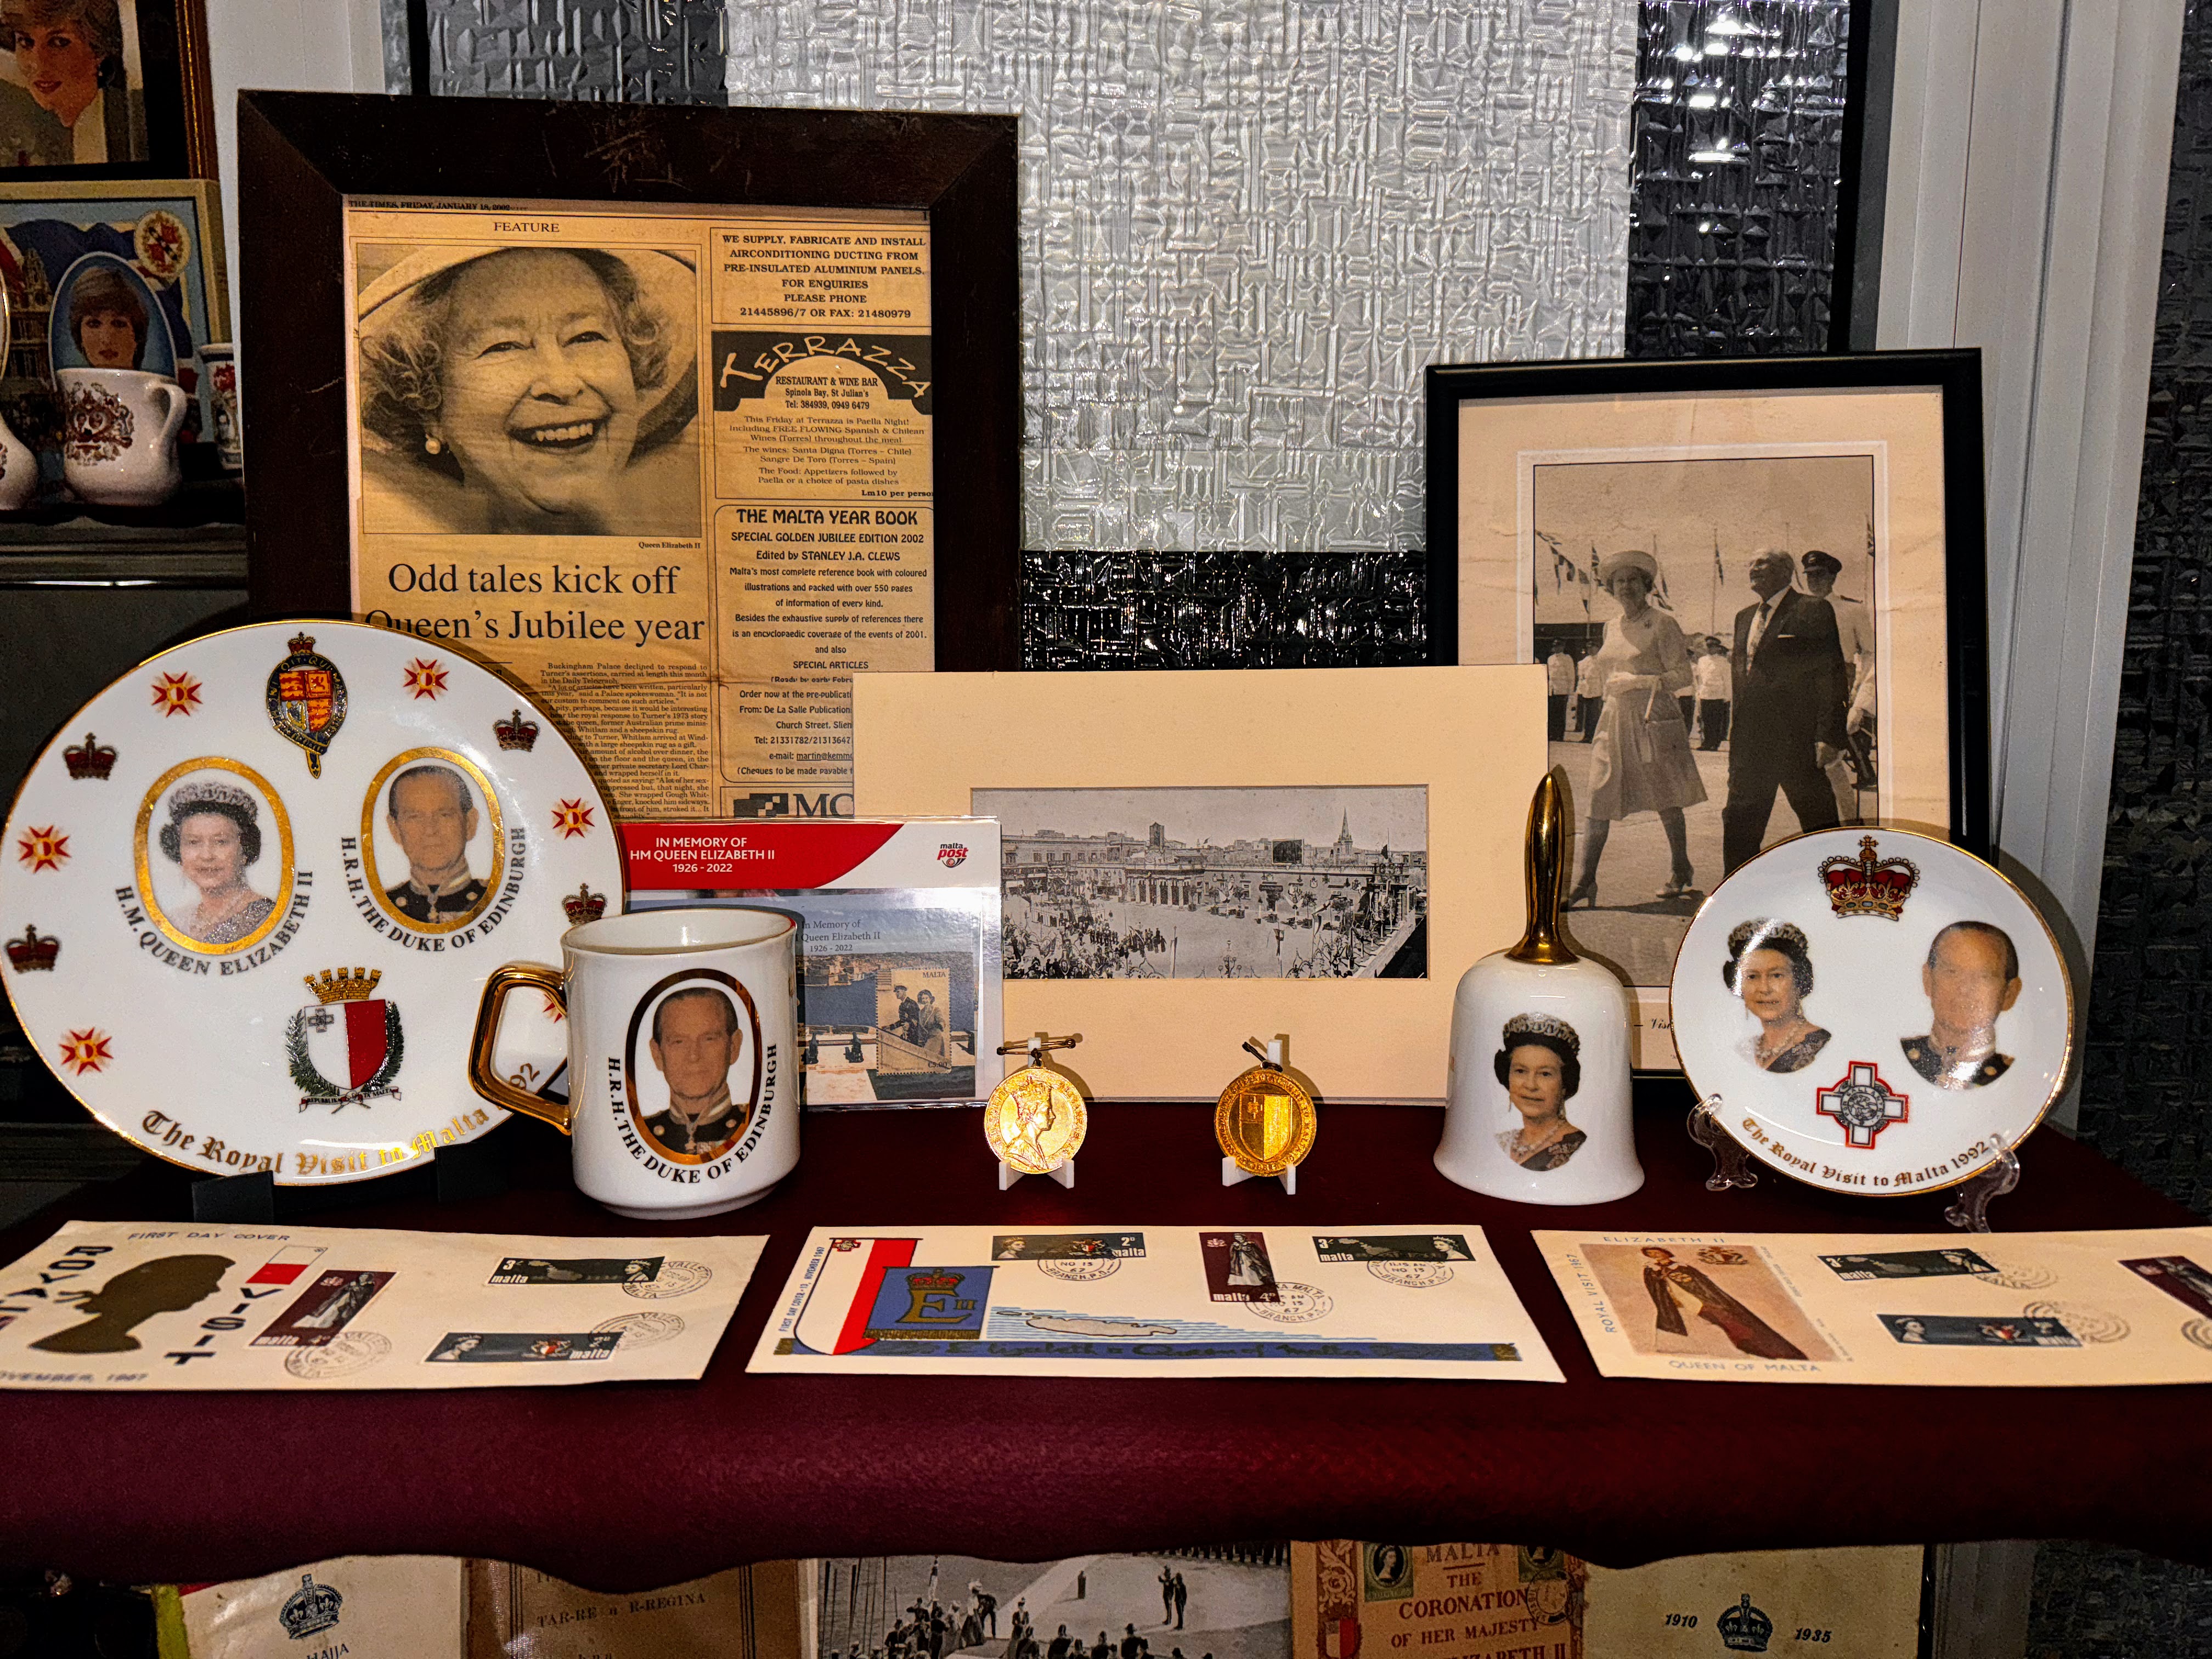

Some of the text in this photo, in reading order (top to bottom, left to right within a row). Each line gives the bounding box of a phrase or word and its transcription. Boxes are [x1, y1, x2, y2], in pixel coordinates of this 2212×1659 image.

[494, 222, 560, 232] FEATURE
[743, 236, 786, 245] SUPPLY,
[790, 236, 850, 245] FABRICATE
[856, 237, 877, 245] AND
[881, 238, 926, 246] INSTALL
[730, 250, 830, 259] AIRCONDITIONING
[834, 251, 882, 259] DUCTING
[724, 264, 924, 275] PRE-INSULATED ALUMINIUM PANELS.
[809, 280, 868, 289] ENQUIRIES
[740, 308, 805, 317] 21445896/7
[810, 309, 826, 317] OR
[859, 310, 910, 318] 21480979
[720, 336, 931, 397] TERRAZZA
[776, 376, 878, 387] RESTAURANT & WINE BAR
[786, 388, 868, 398] Spinola Bay, St Julian's
[786, 400, 870, 410] Tel: 384939, 0949 6479
[737, 509, 917, 525] THE MALTA YEAR BOOK
[731, 532, 923, 543] SPECIAL GOLDEN JUBILEE EDITION 2002
[639, 541, 661, 550] Queen
[757, 551, 900, 561] Edited by STANLEY J.A. CLEWS
[388, 563, 680, 594] Odd tales kick off
[509, 611, 624, 639] Jubilee
[635, 619, 704, 647] year
[656, 837, 747, 848] IN MEMORY OF
[630, 849, 774, 862] HM QUEEN ELIZABETH II
[937, 846, 968, 860] post
[673, 864, 697, 873] 1926
[706, 863, 732, 873] 2022
[388, 927, 444, 951] DUKE
[452, 929, 478, 949] OF
[482, 826, 526, 935] EDINBURGH
[140, 930, 211, 974] QUEEN
[221, 890, 310, 975] ELIZABETH
[297, 870, 313, 887] II
[814, 921, 849, 930] Memory
[801, 934, 829, 942] Queen
[832, 932, 871, 940] Elizabeth
[644, 1156, 700, 1183] DUKE
[708, 1159, 733, 1180] OF
[735, 1044, 776, 1163] EDINBURGH
[142, 1108, 489, 1175] The Royal Visit to Malta
[1742, 1117, 1989, 1187] The Royal Visit to Malta 1992
[128, 1232, 178, 1240] FIRST
[491, 1274, 528, 1284] malta
[1569, 1254, 1616, 1333] ROYAL VISIT 1967
[954, 1300, 978, 1311] II
[569, 1348, 611, 1359] malta
[1669, 1360, 1821, 1373] QUEEN OF MALTA
[1446, 1572, 1482, 1588] THE
[1399, 1589, 1528, 1619] CORONATION
[1391, 1617, 1538, 1647] OF HER MAJESTY
[1666, 1614, 1832, 1643] 1910 1935
